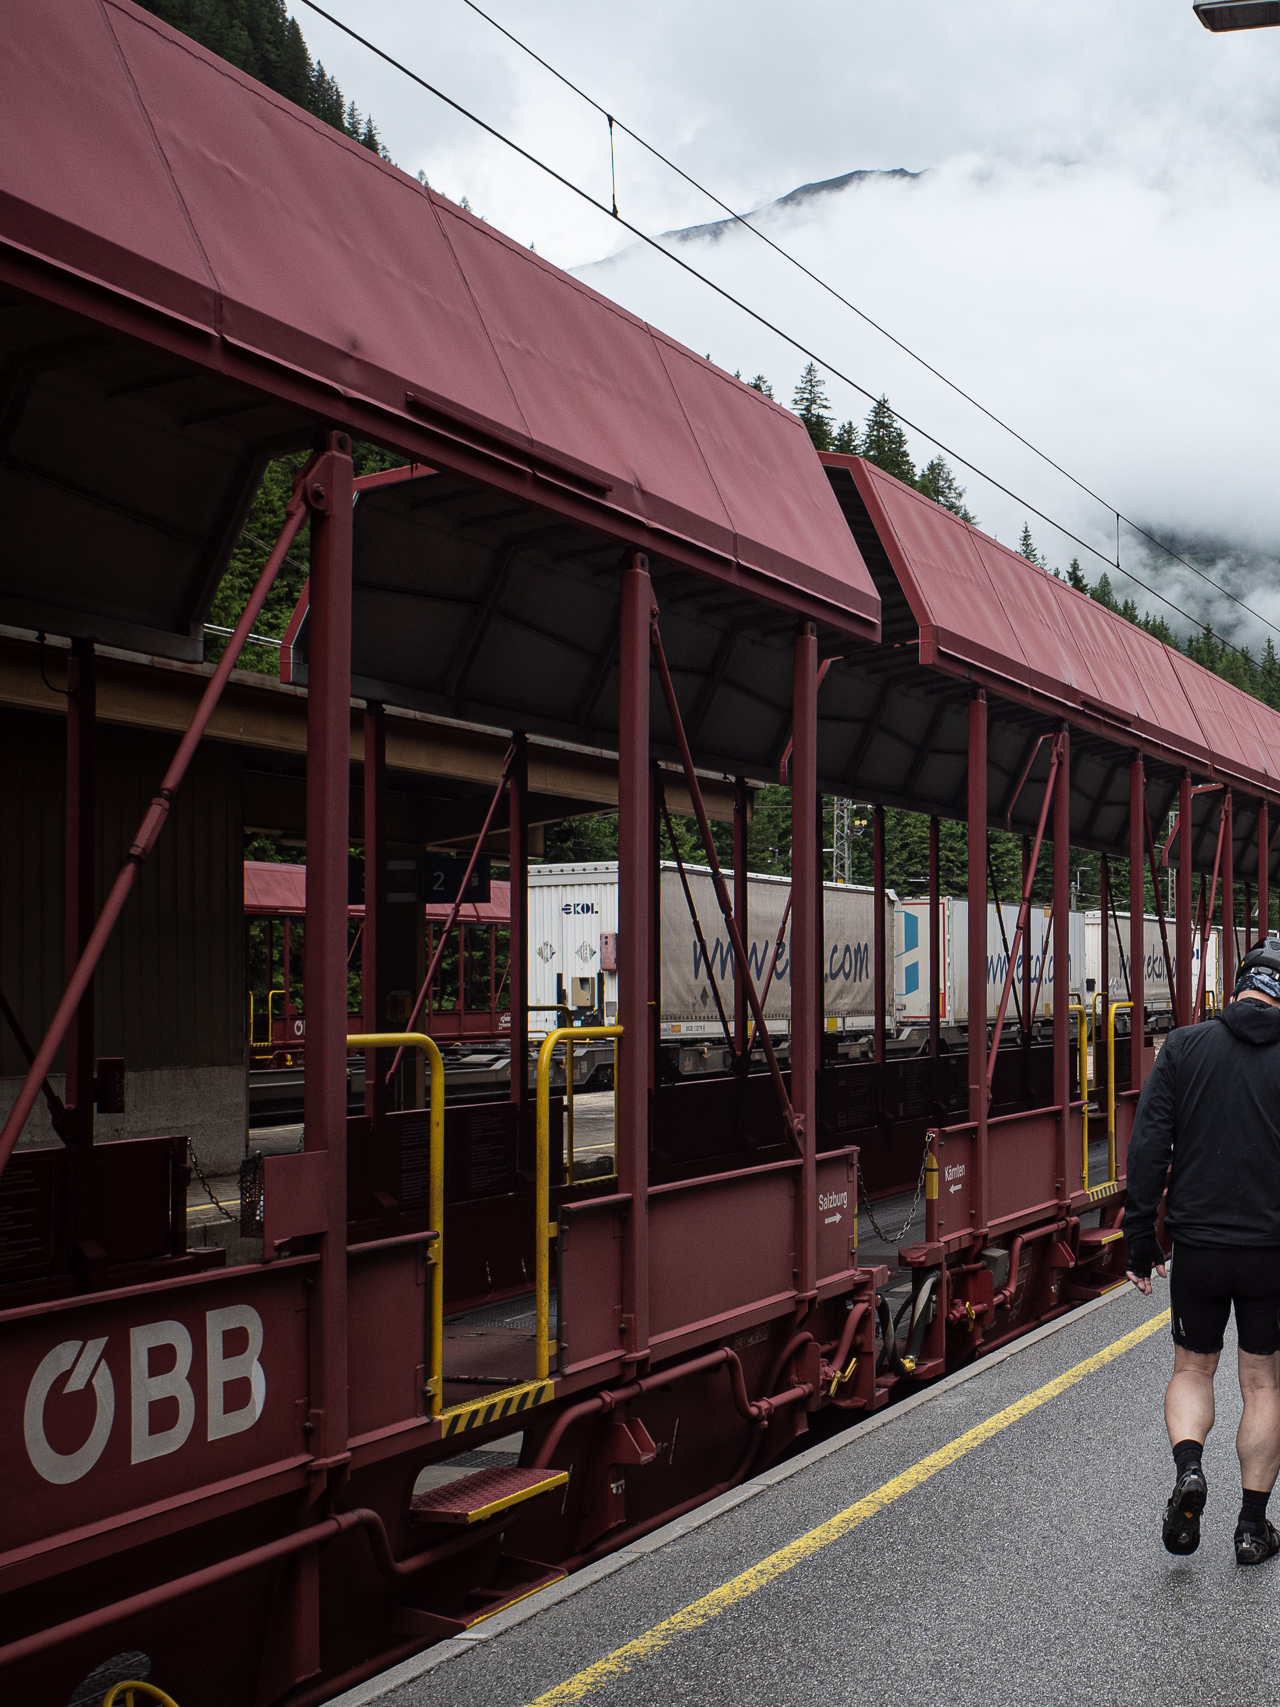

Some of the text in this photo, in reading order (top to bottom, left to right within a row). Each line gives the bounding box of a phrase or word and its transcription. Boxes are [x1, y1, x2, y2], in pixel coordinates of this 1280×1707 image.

[432, 871, 445, 891] 2
[561, 902, 599, 915] EKOL
[944, 1163, 966, 1182] Kärnten
[818, 1190, 848, 1211] Salzburg
[23, 1303, 267, 1485] ÖBB
